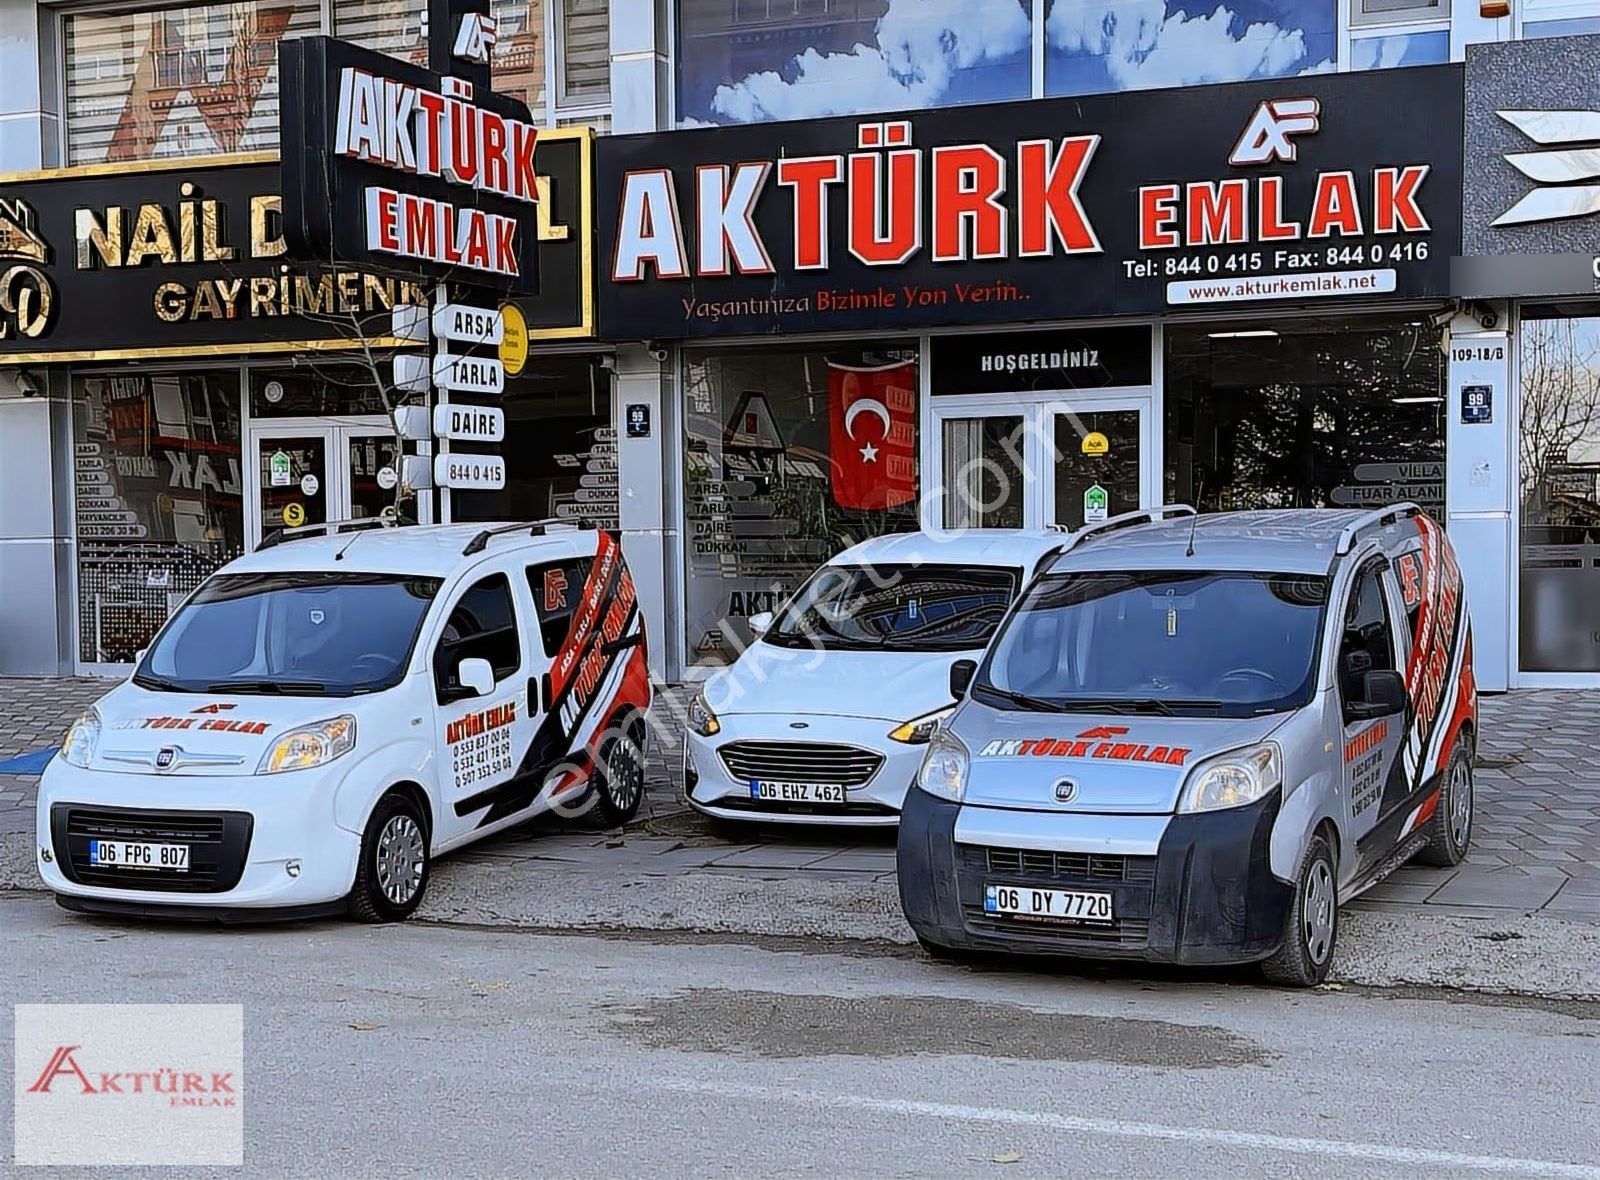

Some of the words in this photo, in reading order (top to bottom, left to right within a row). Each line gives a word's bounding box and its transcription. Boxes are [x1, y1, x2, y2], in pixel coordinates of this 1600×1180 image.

[336, 67, 539, 203] AKTÜRK
[612, 121, 1104, 282] AKTÜRK
[1139, 165, 1432, 250] EMLAK
[75, 182, 233, 269] NAİL
[366, 186, 520, 277] EMLAK
[1123, 259, 1158, 278] Tel:
[1165, 257, 1201, 276] 844
[1208, 256, 1219, 273] 0
[1225, 252, 1262, 272] 415
[1275, 250, 1319, 269] Fax:
[1327, 246, 1364, 265] 844
[1371, 245, 1383, 262] 0
[1389, 242, 1428, 261] 416
[1189, 274, 1377, 299] www.akturkemlak.net
[816, 288, 896, 311] Bizimle
[454, 312, 494, 337] ARSA
[981, 347, 1099, 373] HOŞGELDİNİZ
[452, 361, 497, 386] TARLA
[452, 409, 496, 435] DAİRE
[450, 465, 470, 480] 844
[473, 466, 480, 480] 0
[483, 466, 501, 481] 415
[695, 484, 728, 494] ARSA
[1352, 488, 1392, 499] FUAR
[1397, 486, 1442, 498] ALANI
[568, 505, 618, 513] HAYVANCIL
[694, 503, 733, 514] TARLA
[696, 522, 732, 533] DAİRE
[697, 540, 747, 552] DÜKKAN
[729, 584, 793, 617] AKTÜ
[979, 738, 1093, 758] AKTÜRK
[1092, 742, 1192, 766] EMLAK
[760, 783, 776, 797] 06
[783, 785, 808, 800] EHZ
[814, 786, 841, 801] 462
[100, 843, 116, 860] 06
[125, 845, 151, 863] FPG
[160, 847, 187, 865] 807
[998, 889, 1018, 909] 06
[1032, 891, 1053, 912] DY
[1064, 894, 1109, 916] 7720
